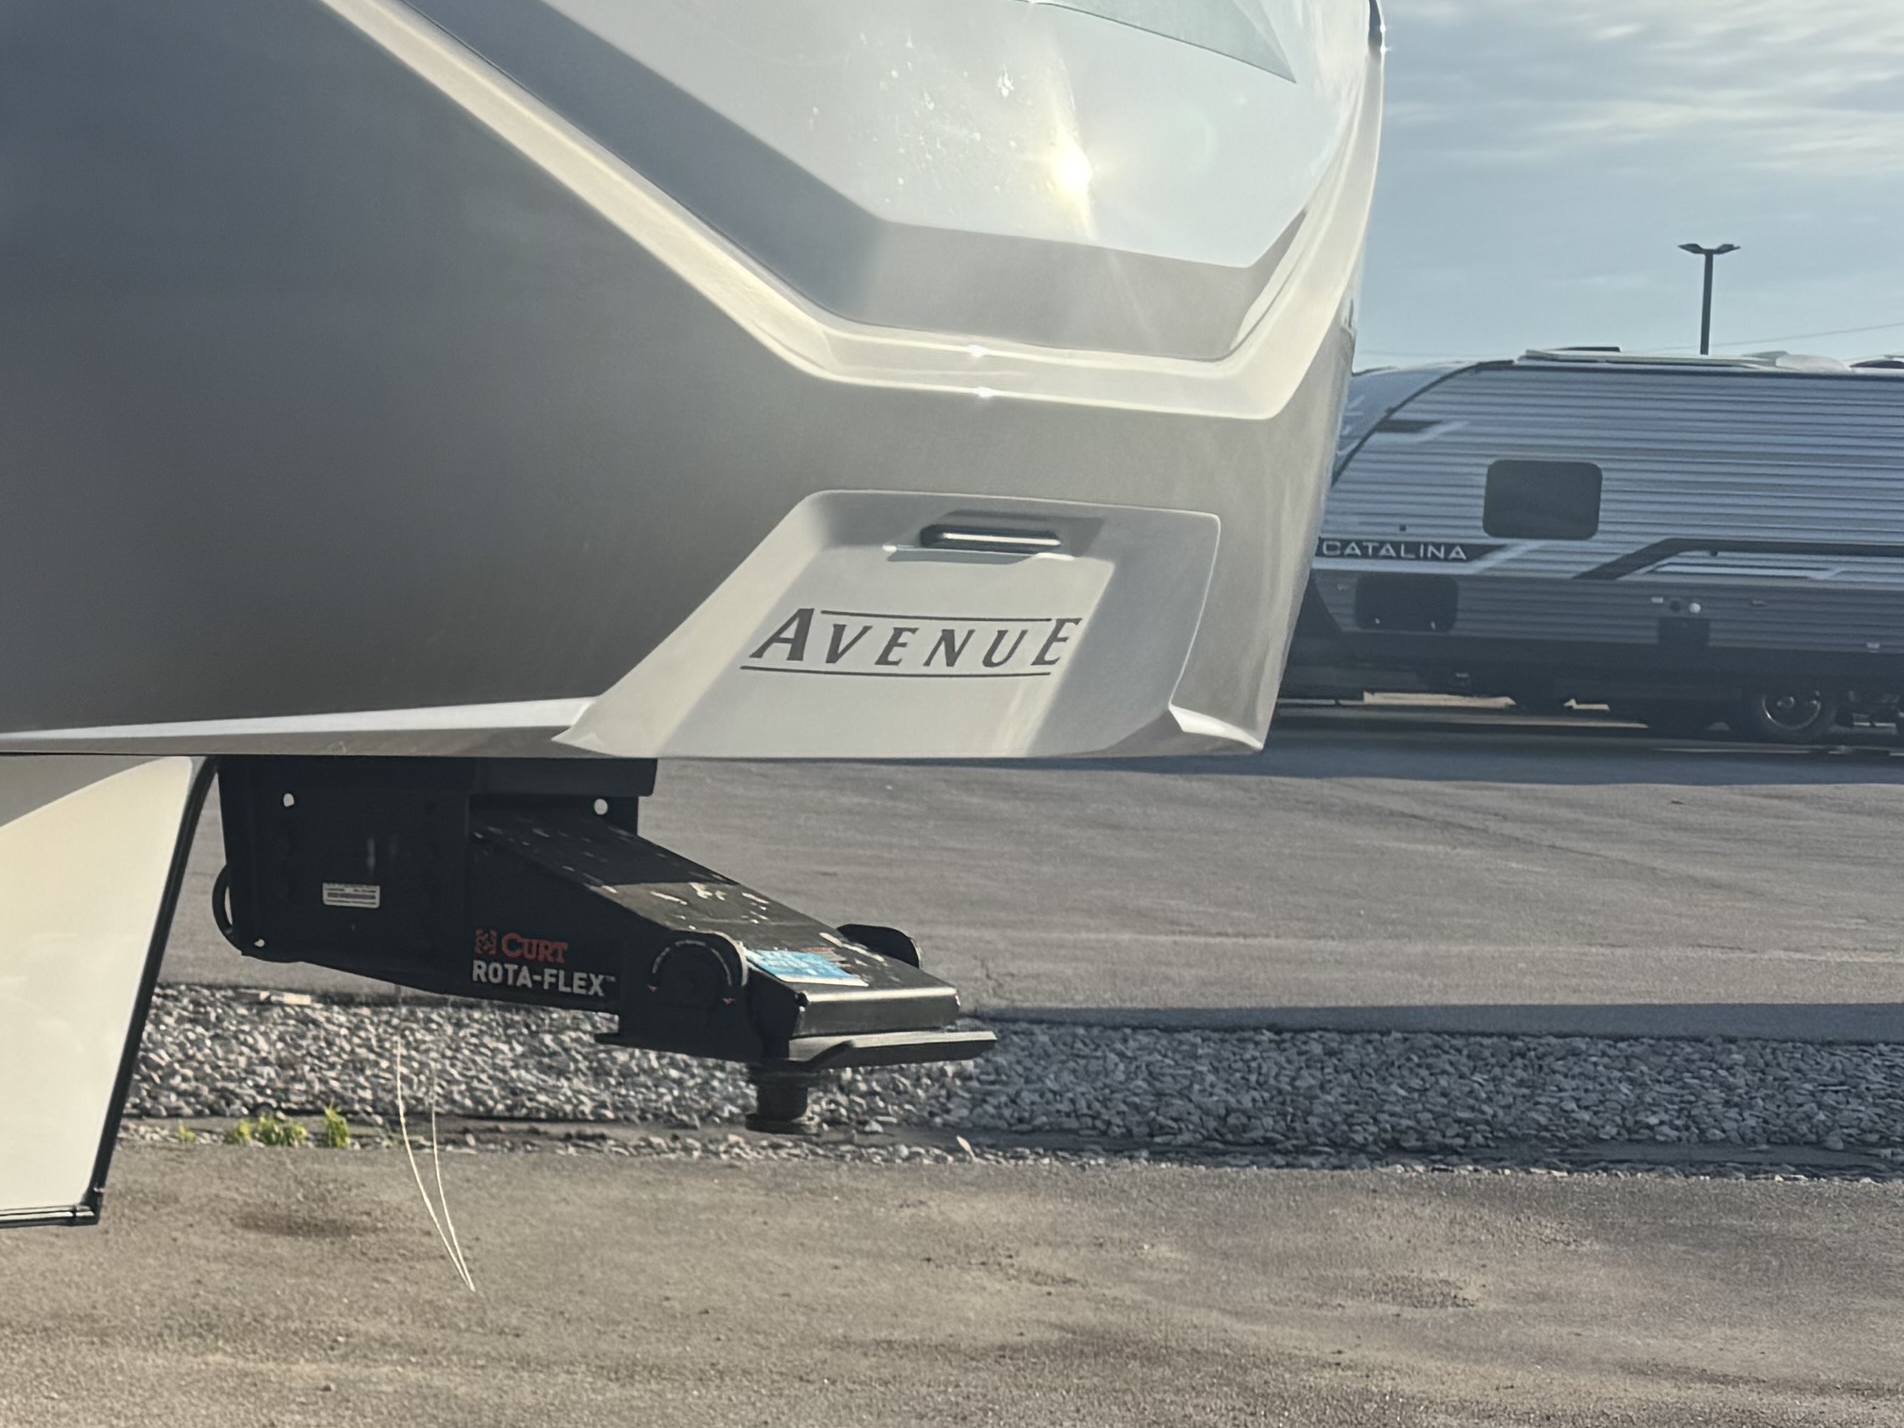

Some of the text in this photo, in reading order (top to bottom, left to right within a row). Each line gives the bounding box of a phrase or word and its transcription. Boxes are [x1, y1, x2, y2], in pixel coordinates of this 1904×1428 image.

[1322, 540, 1467, 561] CATALINA
[748, 607, 1083, 668] AVENUE
[501, 932, 569, 965] CURT
